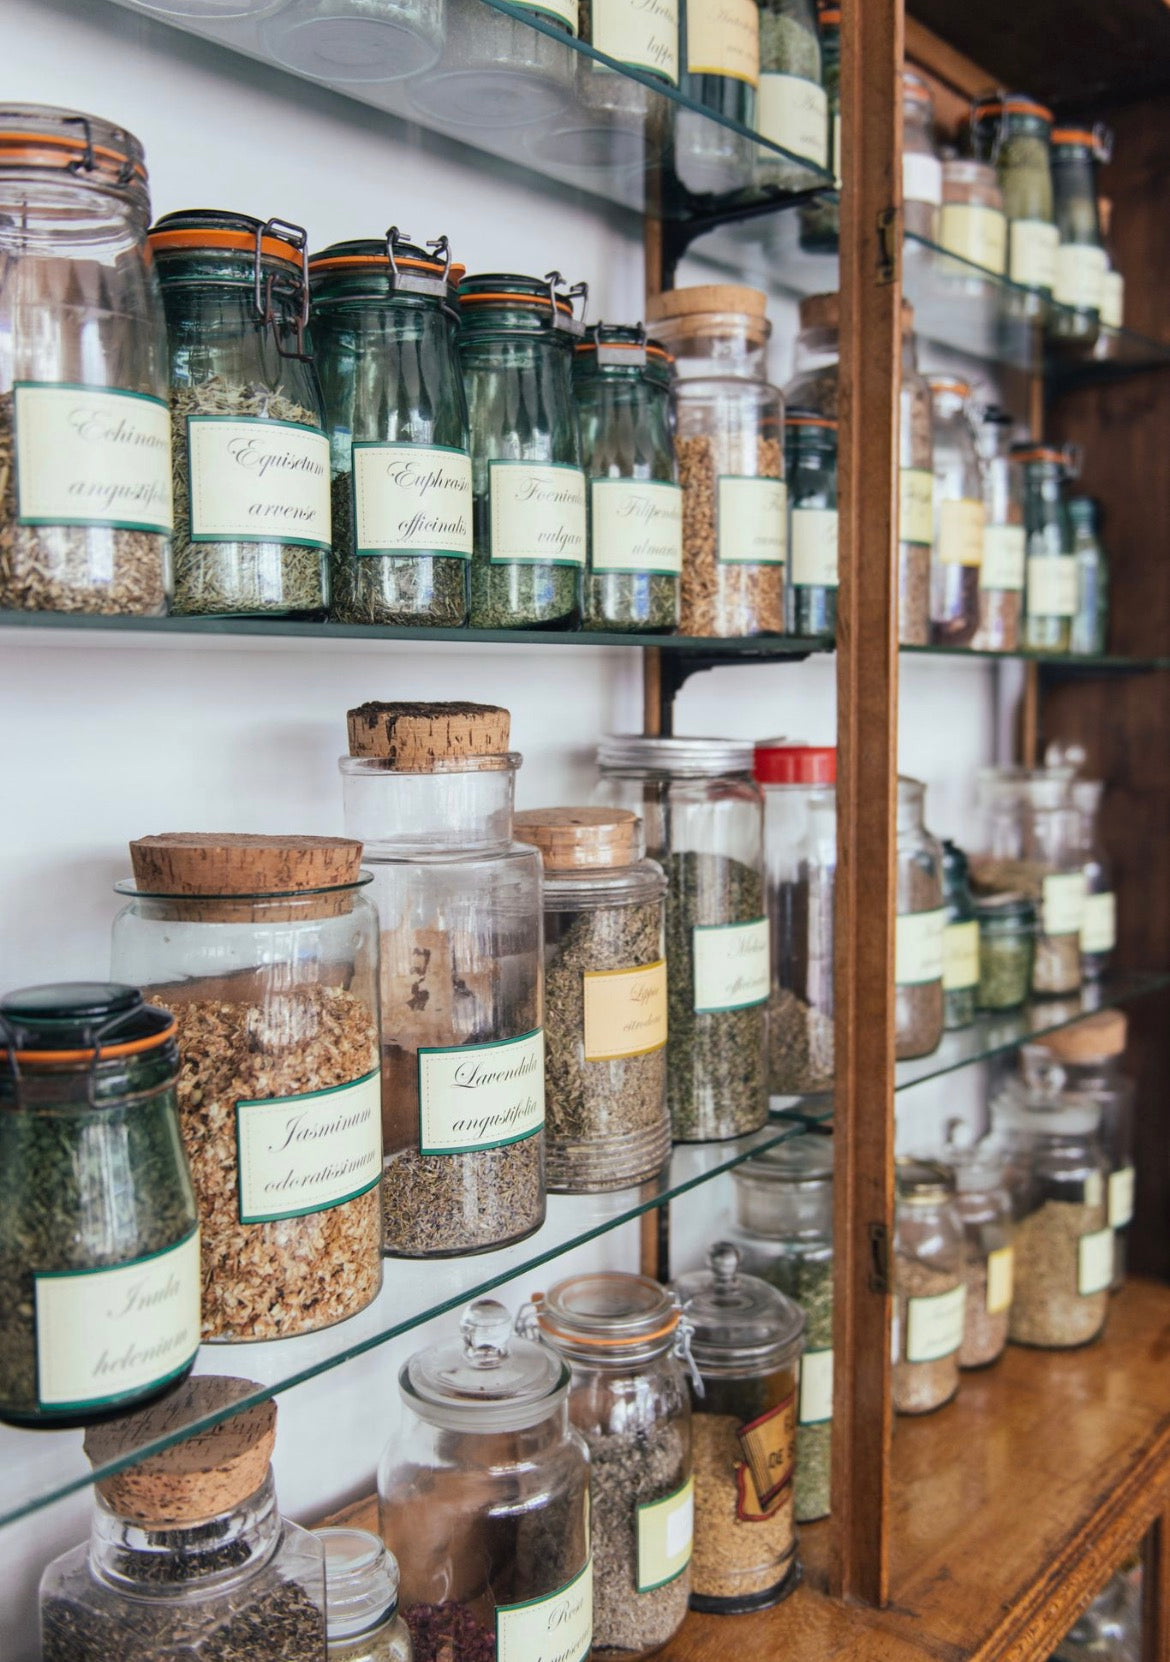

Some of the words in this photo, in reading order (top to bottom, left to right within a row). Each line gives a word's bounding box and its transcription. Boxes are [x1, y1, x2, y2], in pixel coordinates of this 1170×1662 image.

[227, 437, 324, 477] Equisetum
[248, 501, 317, 522] arvense
[397, 510, 467, 541] officinalis
[450, 1053, 538, 1089] Lavendula
[267, 1105, 372, 1154] Jasminum
[452, 1096, 538, 1138] angustifolia
[264, 1149, 376, 1193] odoratissimum
